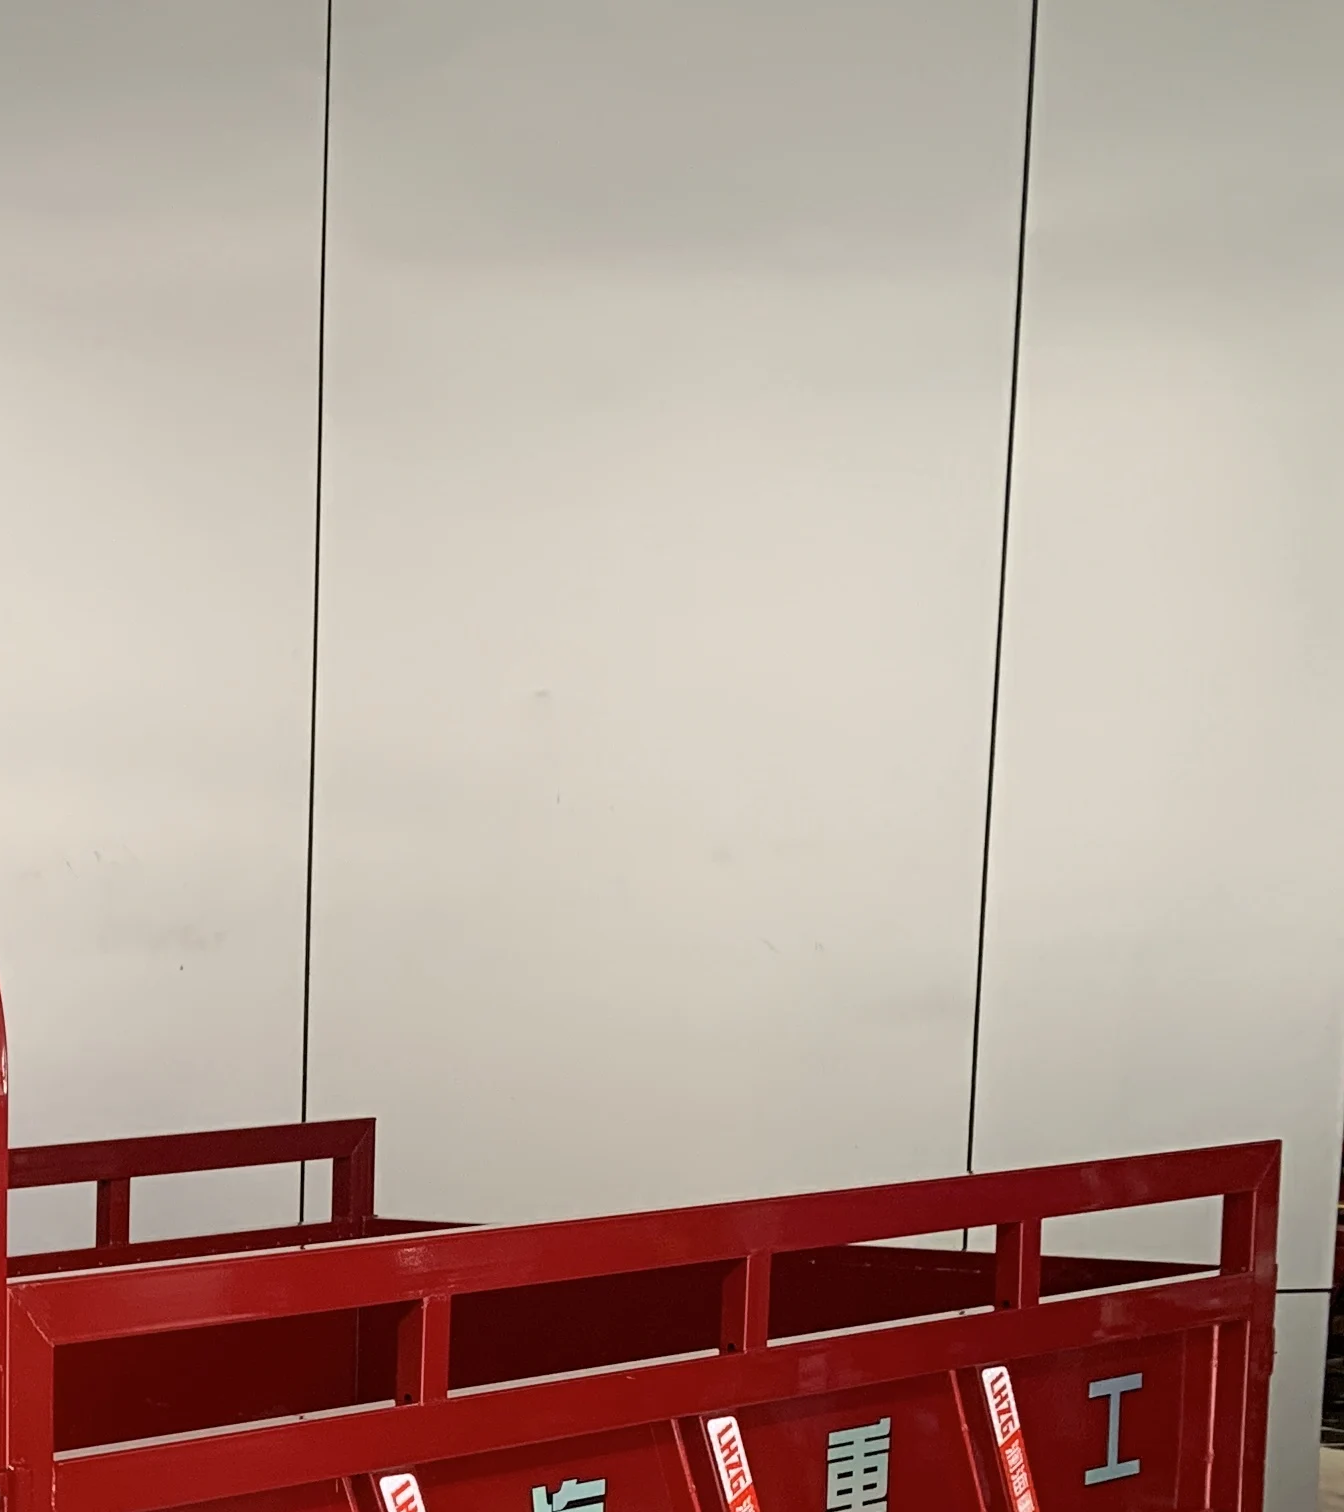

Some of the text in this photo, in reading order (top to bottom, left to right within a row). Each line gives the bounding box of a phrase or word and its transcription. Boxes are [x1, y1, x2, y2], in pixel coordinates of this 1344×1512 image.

[990, 1373, 1017, 1444] LHZG
[1084, 1372, 1143, 1486] 工
[717, 1422, 747, 1496] LHZG
